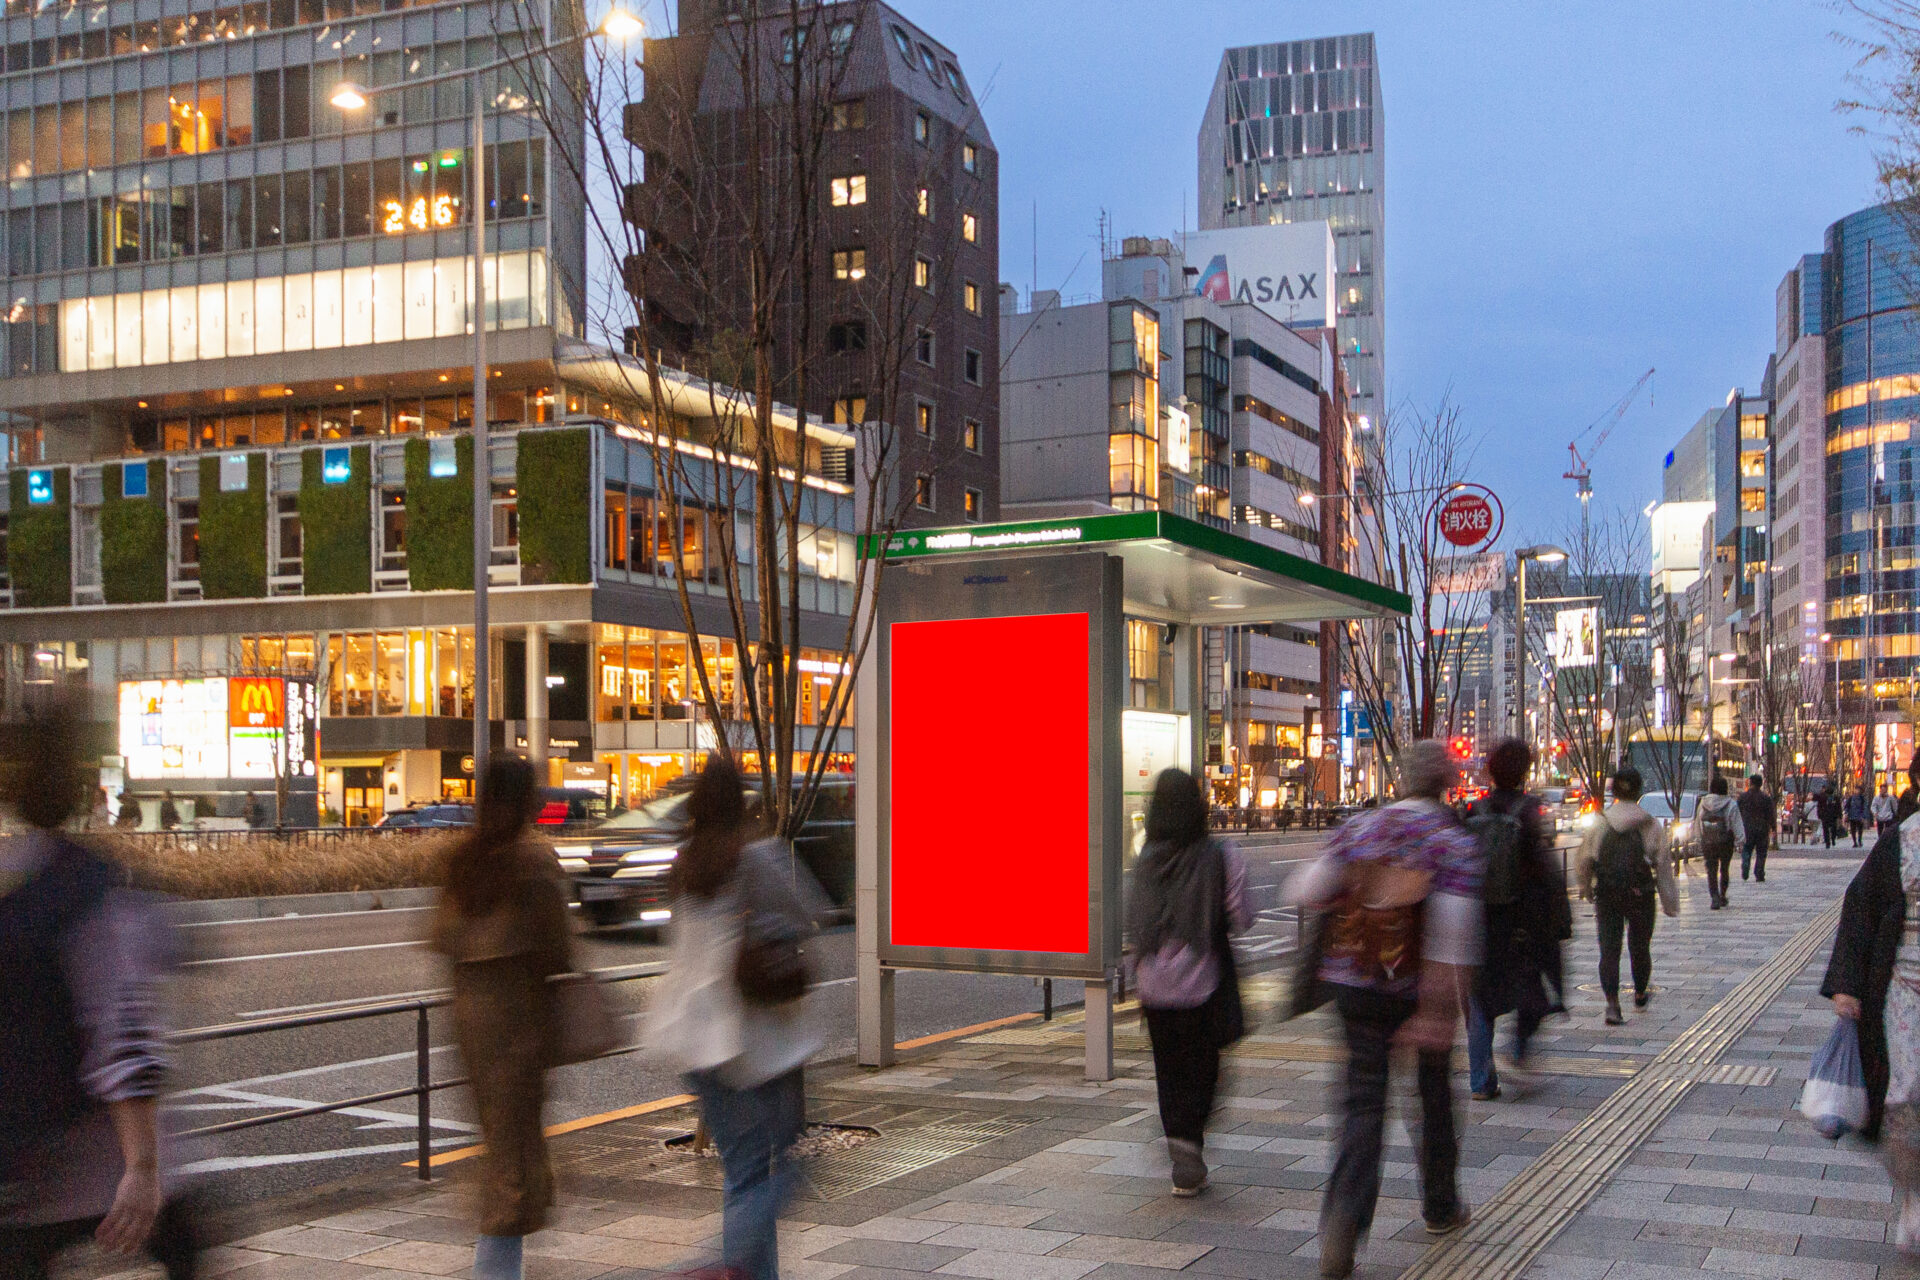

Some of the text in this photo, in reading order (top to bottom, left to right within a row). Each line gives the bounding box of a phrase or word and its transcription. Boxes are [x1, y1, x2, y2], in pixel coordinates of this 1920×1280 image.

[384, 194, 452, 233] 246
[1236, 273, 1318, 304] ASAX
[1444, 508, 1489, 532] 消火栓
